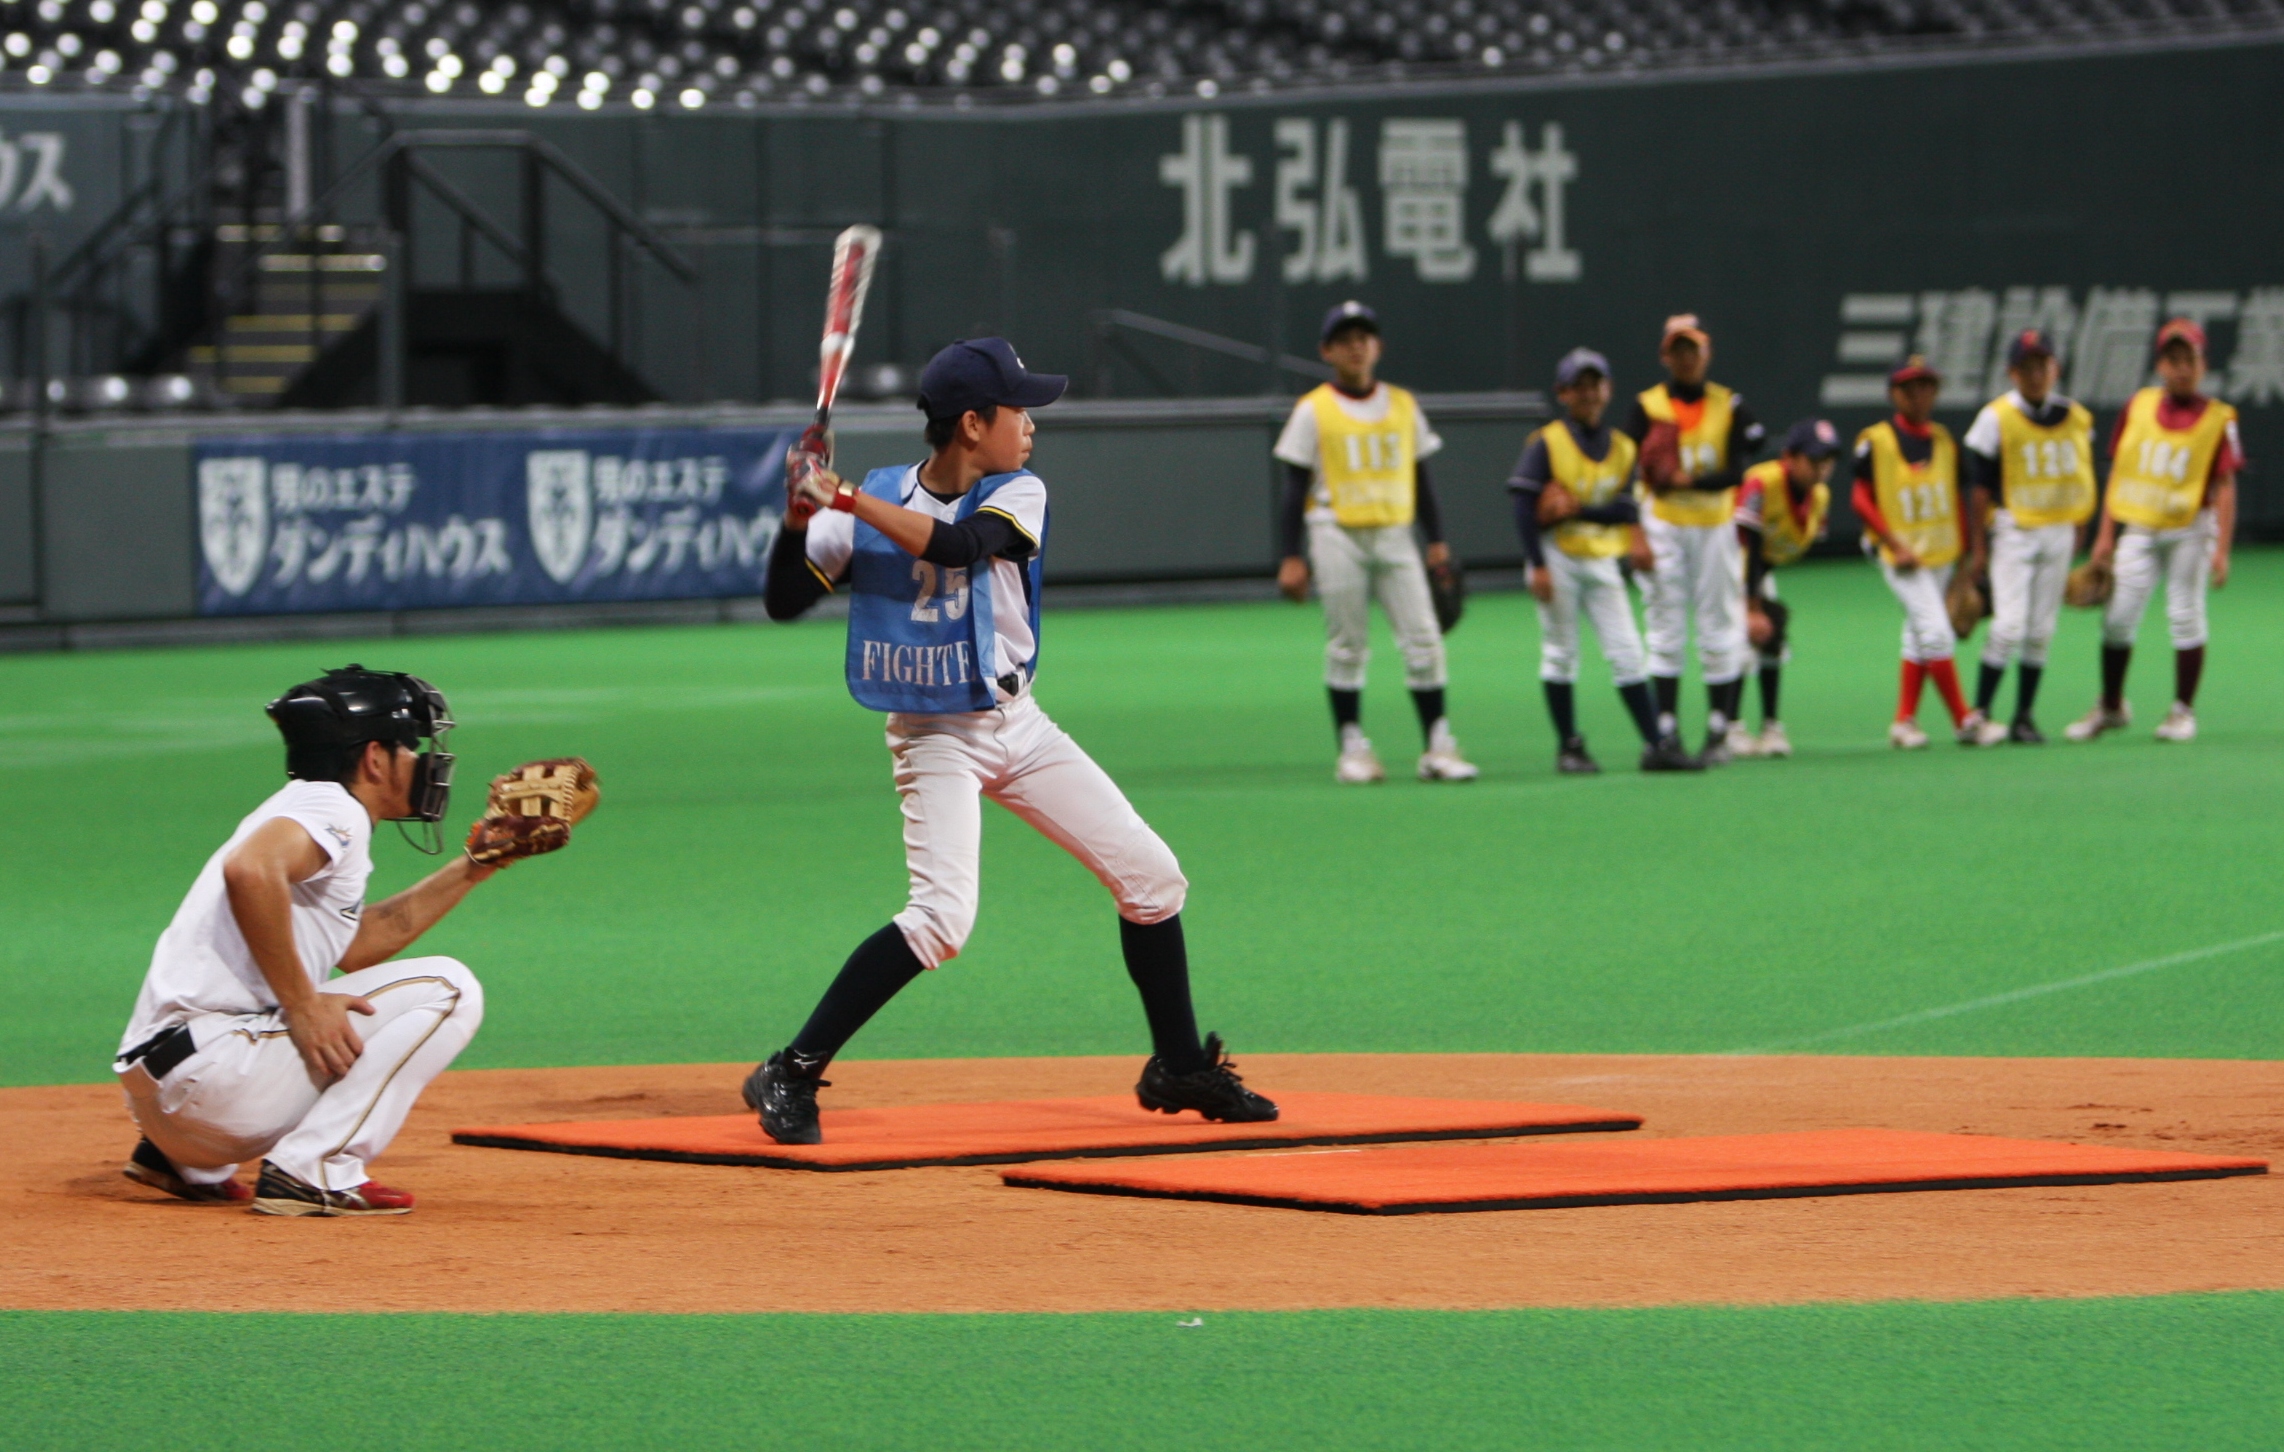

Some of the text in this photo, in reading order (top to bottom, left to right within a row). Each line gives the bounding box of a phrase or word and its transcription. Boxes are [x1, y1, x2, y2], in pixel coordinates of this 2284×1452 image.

[1159, 114, 1583, 285] 北弘電社
[270, 513, 513, 590] ダンディハウス
[590, 503, 784, 580] ダンディハウ
[910, 559, 970, 622] 25
